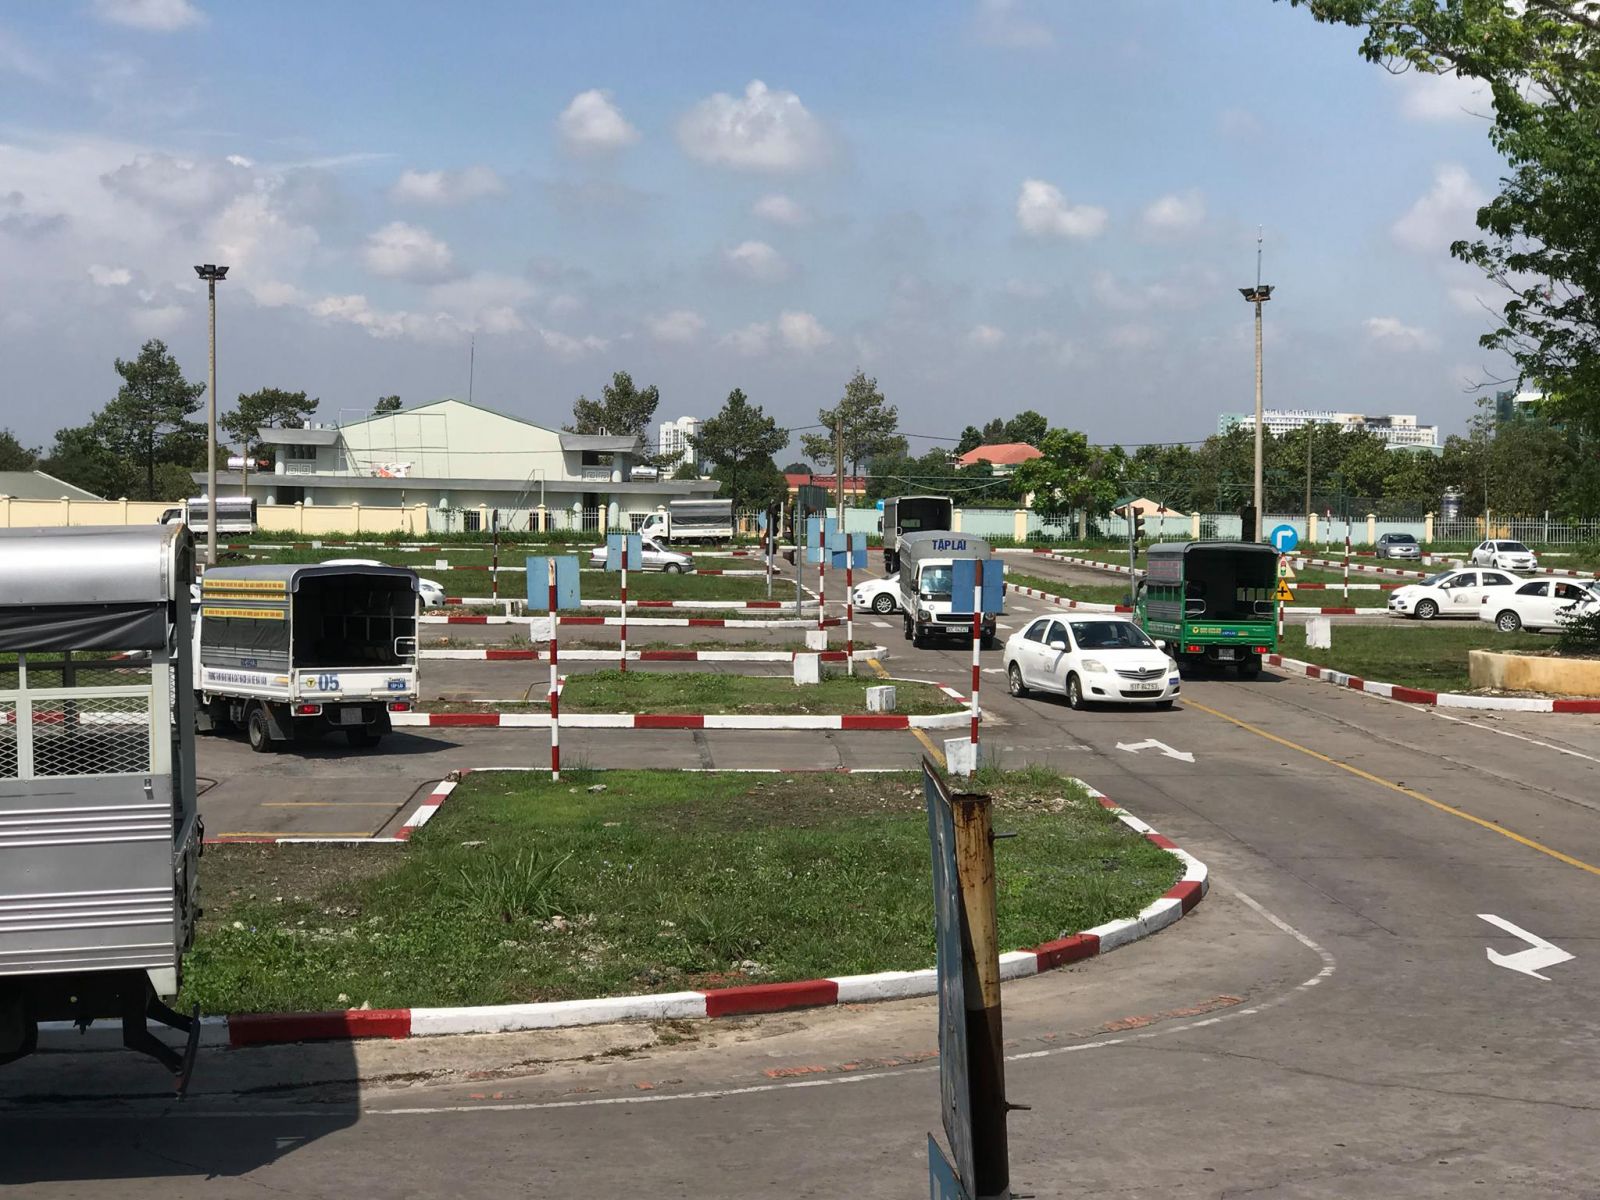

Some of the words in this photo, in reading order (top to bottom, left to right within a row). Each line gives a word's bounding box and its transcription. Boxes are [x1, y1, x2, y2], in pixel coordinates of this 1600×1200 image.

[932, 539, 951, 551] TẬP
[952, 538, 967, 551] LÁI
[318, 673, 340, 691] 05
